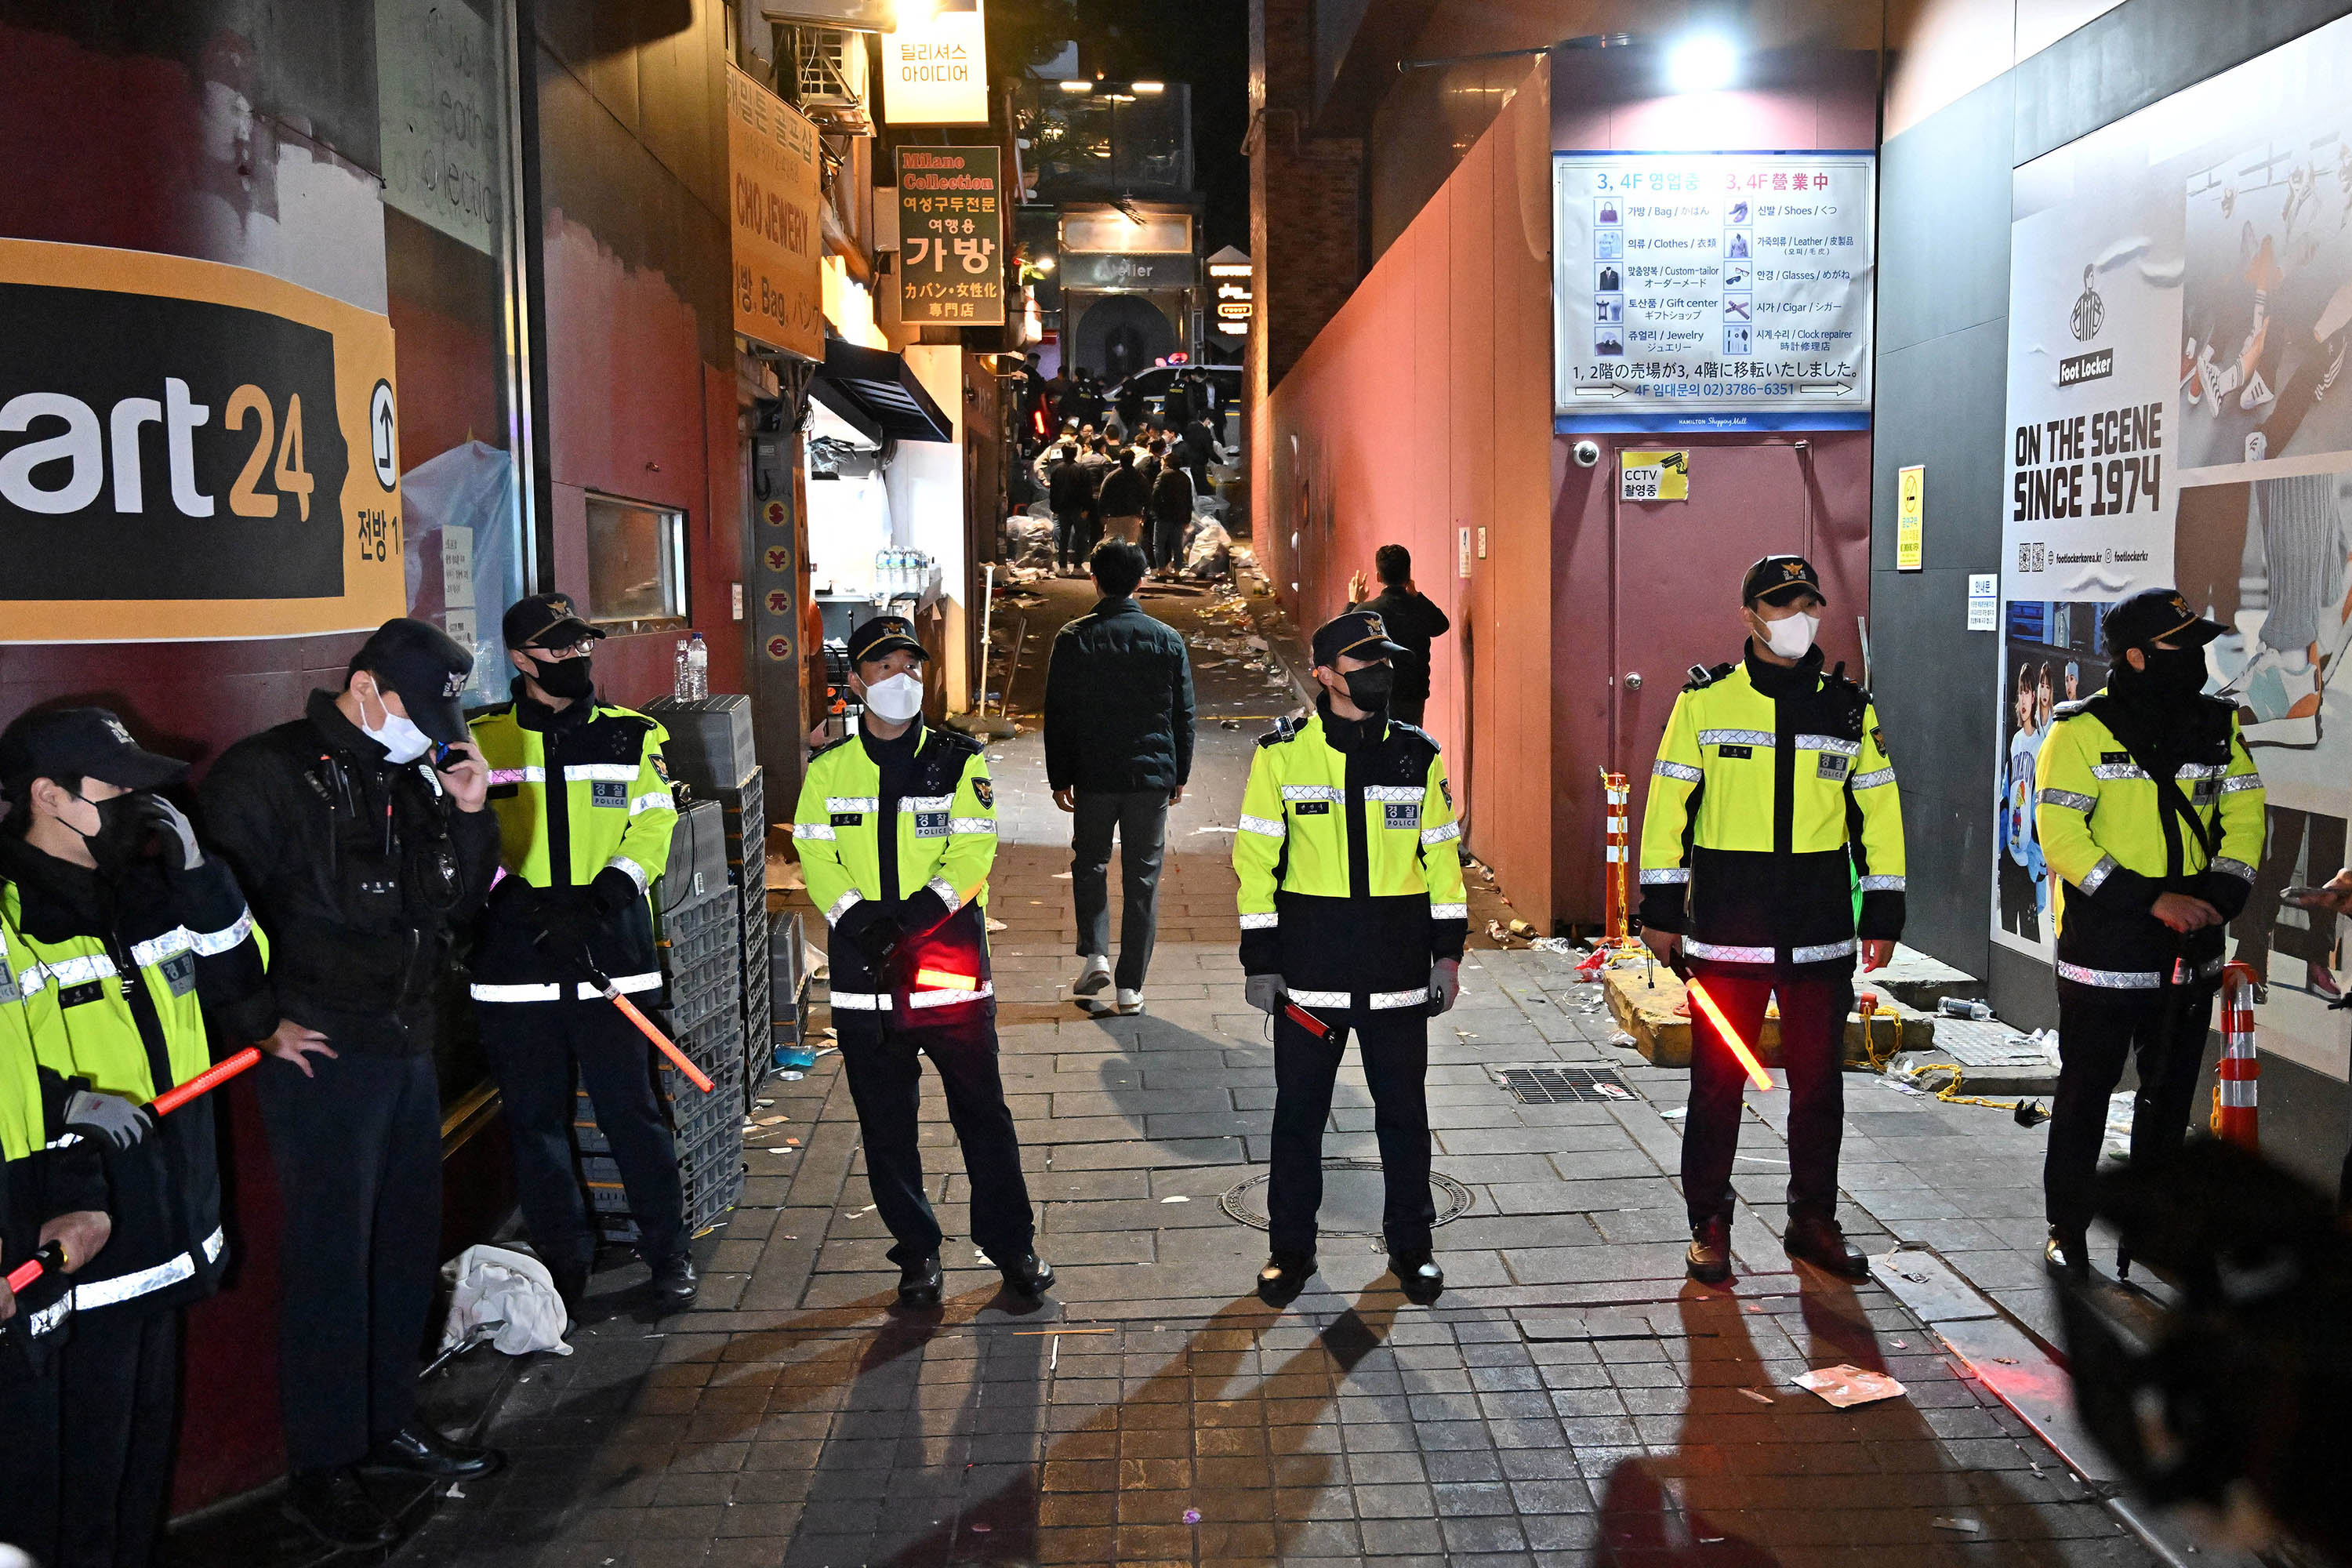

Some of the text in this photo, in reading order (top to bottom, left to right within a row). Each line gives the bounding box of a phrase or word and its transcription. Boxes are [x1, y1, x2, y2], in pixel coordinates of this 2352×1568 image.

[901, 43, 967, 60] 딜리셔스
[902, 64, 968, 82] 아이디어
[775, 104, 812, 165] 골프샵
[903, 153, 965, 169] Milano
[903, 173, 994, 191] Collection
[1597, 172, 1700, 192] 3, 4F 영업중
[1726, 172, 1829, 192] 3, 4F 營業中
[736, 172, 762, 235] CHO
[903, 196, 996, 213] 여성구두전문
[1758, 205, 1775, 216] 신발
[1784, 205, 1812, 216] Shoes
[1820, 206, 1838, 216] くつ
[1628, 205, 1646, 217] 가방
[1654, 207, 1671, 218] Bag
[928, 218, 975, 234] 여행용
[1628, 238, 1646, 249] 의류
[1654, 238, 1688, 249] Clothes
[1697, 238, 1716, 248] 衣類
[1757, 237, 1787, 247] 가죽의류
[1794, 237, 1823, 246] Leather
[1829, 236, 1854, 246] 皮製品
[906, 238, 995, 274] 가방
[1628, 267, 1658, 277] 맞춤양복
[1665, 267, 1719, 276] Custom-tailor
[1757, 270, 1774, 281] 안경
[1782, 270, 1814, 280] Glasses
[1823, 270, 1850, 279] めがね
[905, 281, 997, 299] カバン・女性化
[1645, 278, 1707, 289] オーダーメード
[1628, 299, 1657, 309] 토산품
[1666, 298, 1685, 308] Gift
[1686, 299, 1719, 308] center
[1756, 302, 1775, 313] 시가
[1783, 303, 1806, 314] Cigar
[1816, 302, 1842, 312] シガー
[1644, 310, 1702, 321] ギフトショップ
[1628, 330, 1657, 341] 쥬얼리
[1666, 330, 1704, 342] Jewelry
[1797, 329, 1819, 339] Clock
[1820, 330, 1853, 340] repairer
[1647, 343, 1692, 352] ジュエリー
[1780, 342, 1831, 352] 時計修理店
[1573, 366, 1584, 381] 1,
[1693, 361, 1857, 379] 4階に移転いたしました。
[2061, 355, 2111, 383] Foot Locker
[1635, 385, 1650, 396] 4F
[1653, 383, 1700, 397] 임대문의
[1708, 416, 1733, 426] Shopping
[2015, 402, 2162, 467] ON THE SCENE
[1624, 470, 1657, 481] CCTV
[1624, 485, 1657, 497] 촬영중
[2013, 454, 2161, 521] SINCE 1974
[358, 508, 387, 562] 전방
[2056, 550, 2149, 564] footlockerkorea.kr footlockerkr
[1821, 755, 1846, 770] 경찰
[1819, 769, 1843, 779] POLICE
[595, 784, 624, 797] 경찰
[1388, 805, 1416, 818] 경찰
[918, 813, 948, 827] 경찰
